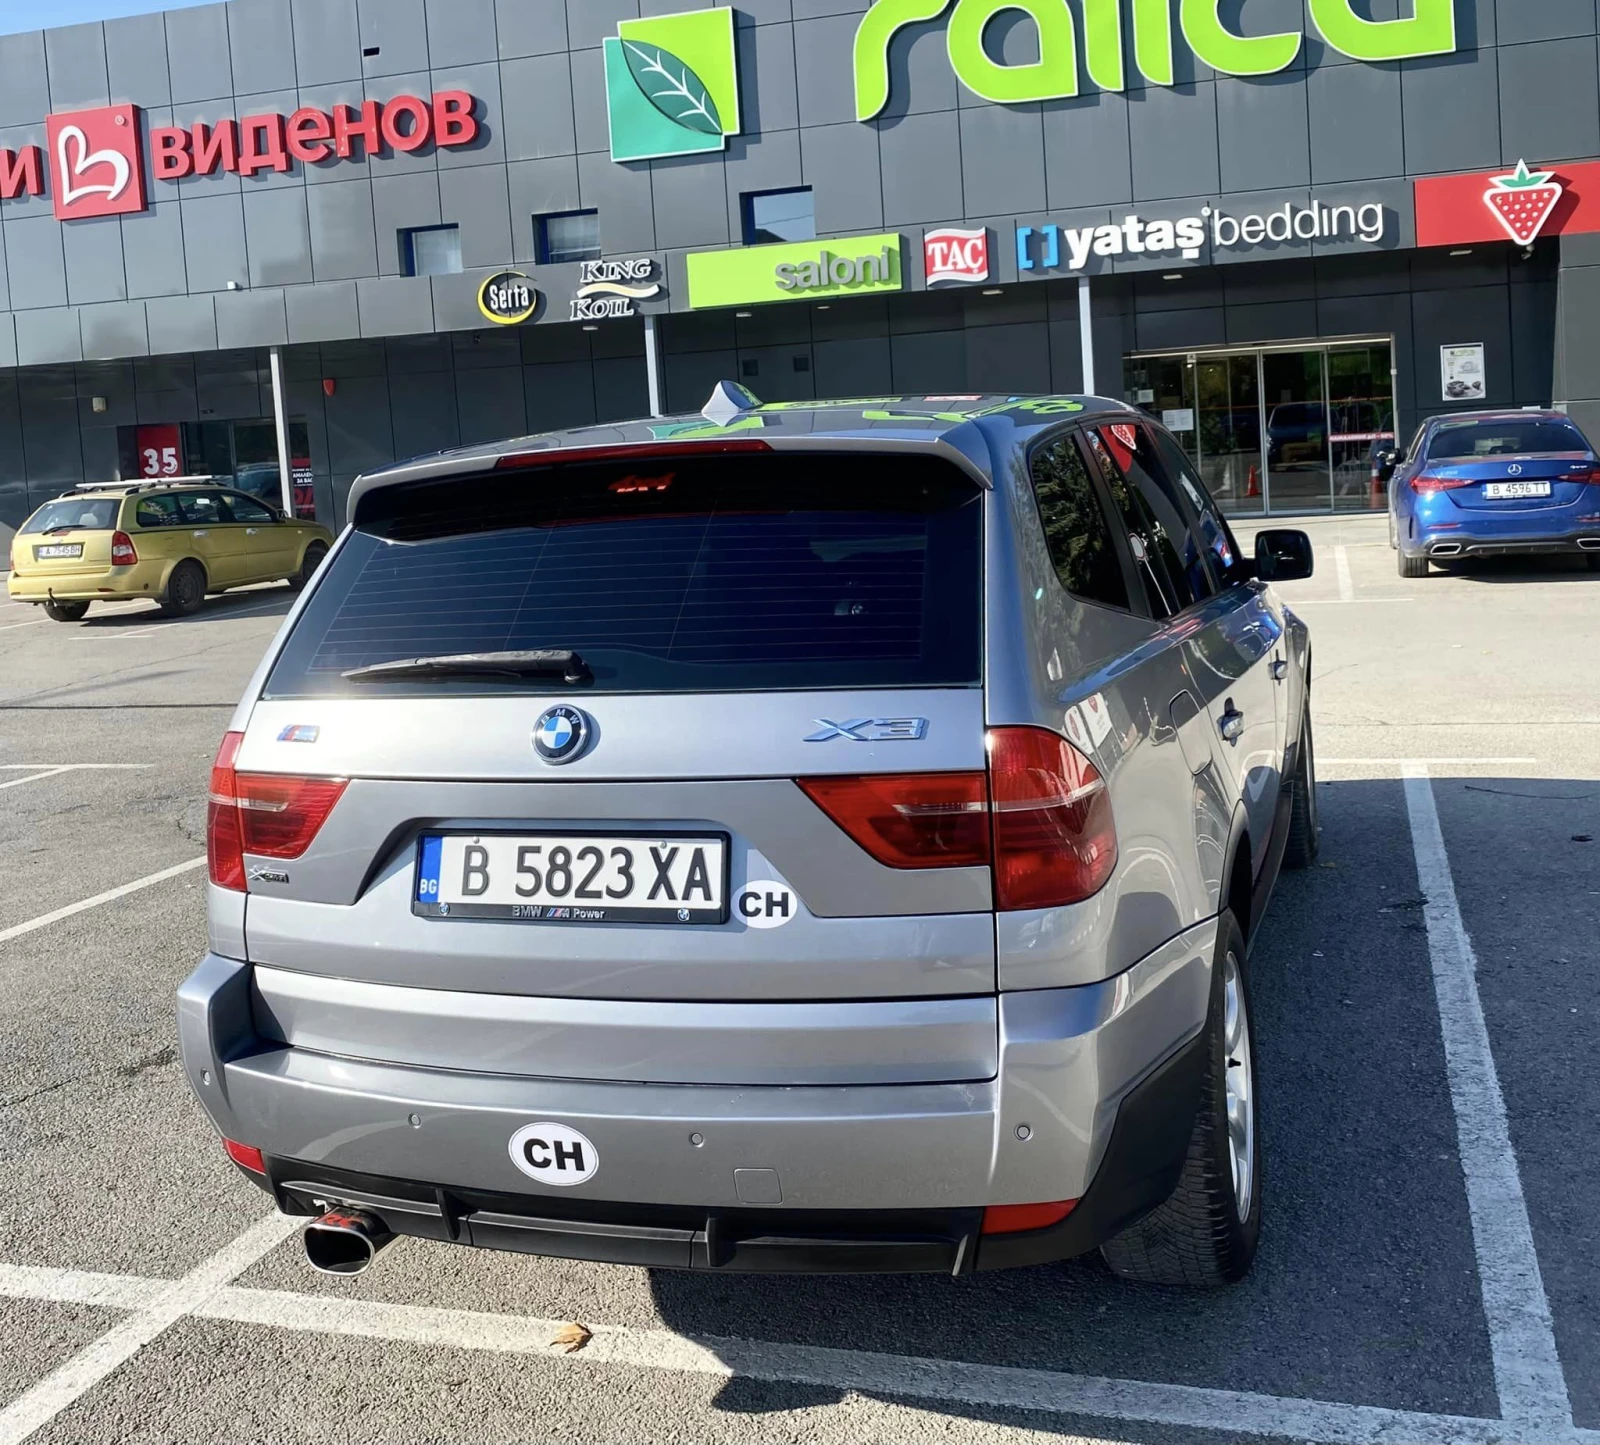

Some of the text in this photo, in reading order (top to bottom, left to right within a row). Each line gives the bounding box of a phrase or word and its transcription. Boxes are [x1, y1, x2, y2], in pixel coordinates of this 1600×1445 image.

[1214, 200, 1383, 242] bedding
[580, 259, 651, 283] KING
[775, 246, 889, 290] saloni
[489, 285, 529, 309] Serta
[570, 298, 634, 321] KOIL
[143, 447, 178, 475] 35
[1492, 482, 1547, 495] B 4596 TT
[540, 708, 579, 724] BMW
[802, 717, 926, 742] X3
[461, 845, 713, 901] B 5823 XA
[420, 878, 437, 894] BG
[512, 905, 542, 917] BMW
[573, 908, 605, 919] Power
[739, 892, 789, 917] CH
[523, 1138, 585, 1171] CH
